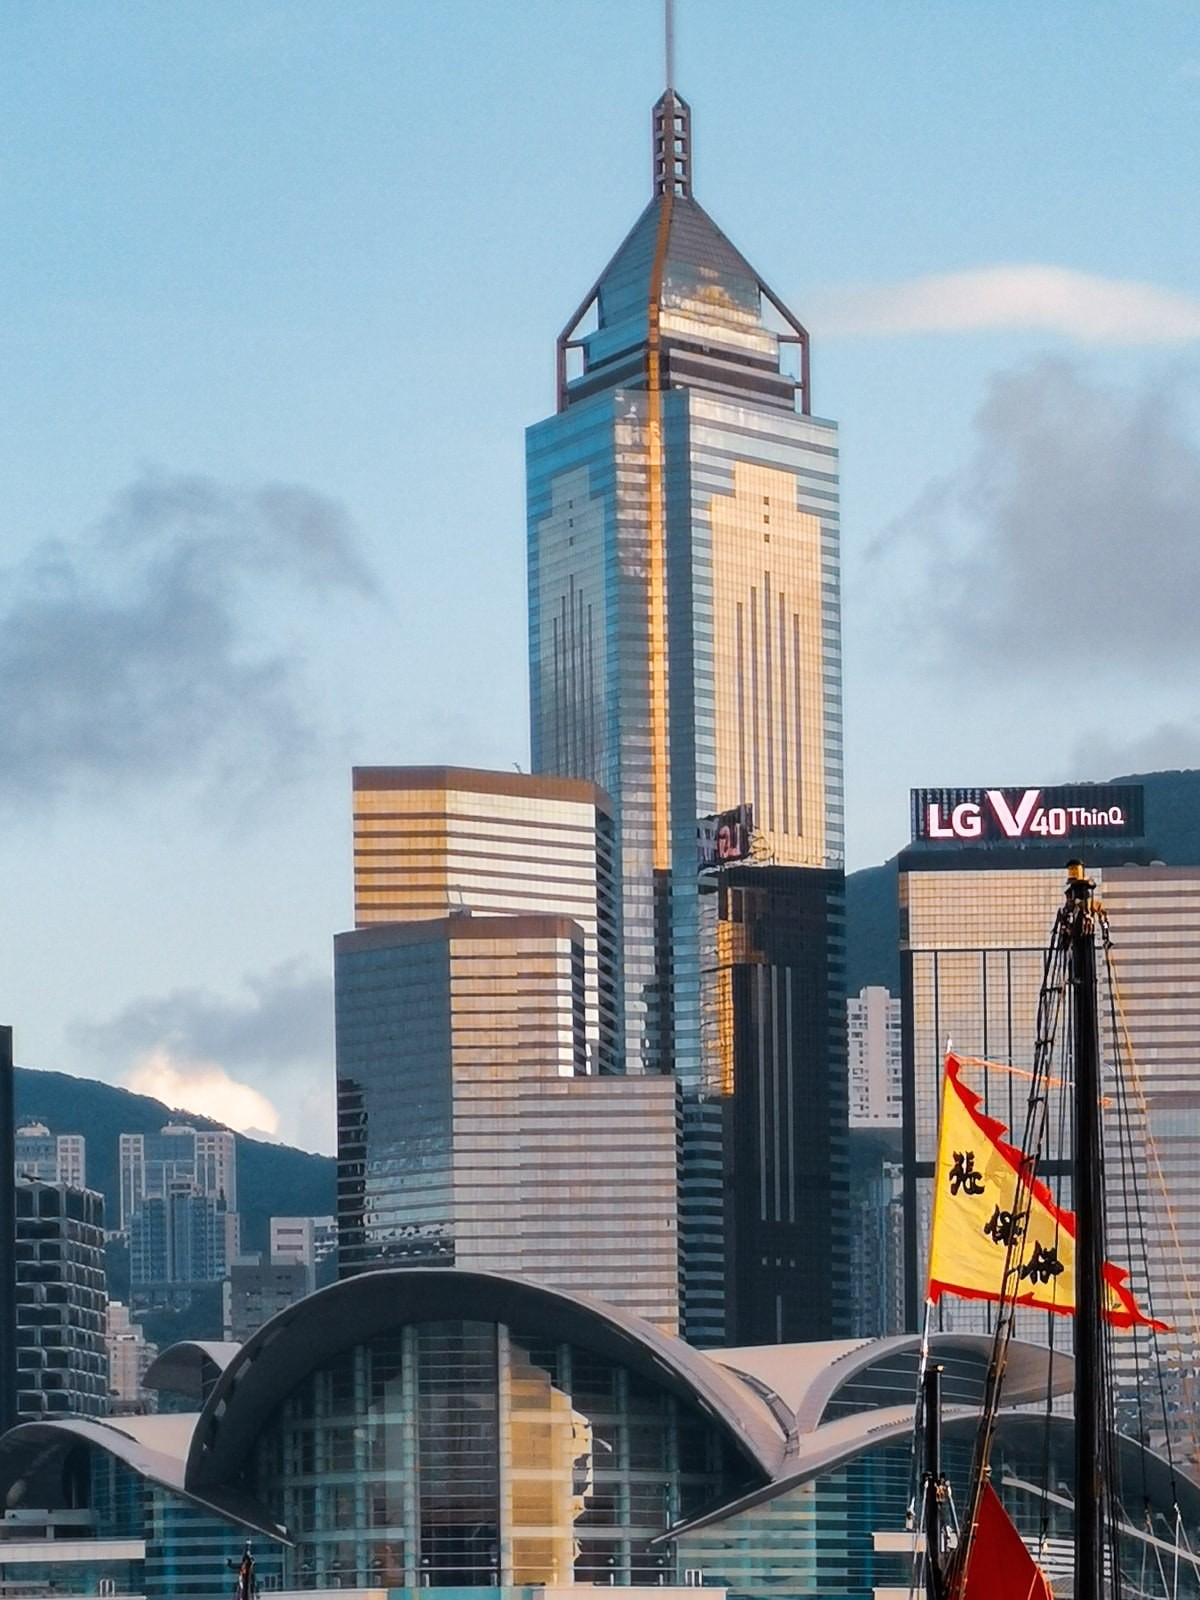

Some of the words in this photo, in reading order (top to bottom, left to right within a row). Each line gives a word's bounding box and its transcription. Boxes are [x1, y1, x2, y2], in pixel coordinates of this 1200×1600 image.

[929, 802, 982, 838] LG
[984, 789, 1069, 837] V40
[1067, 806, 1125, 826] ThinQ
